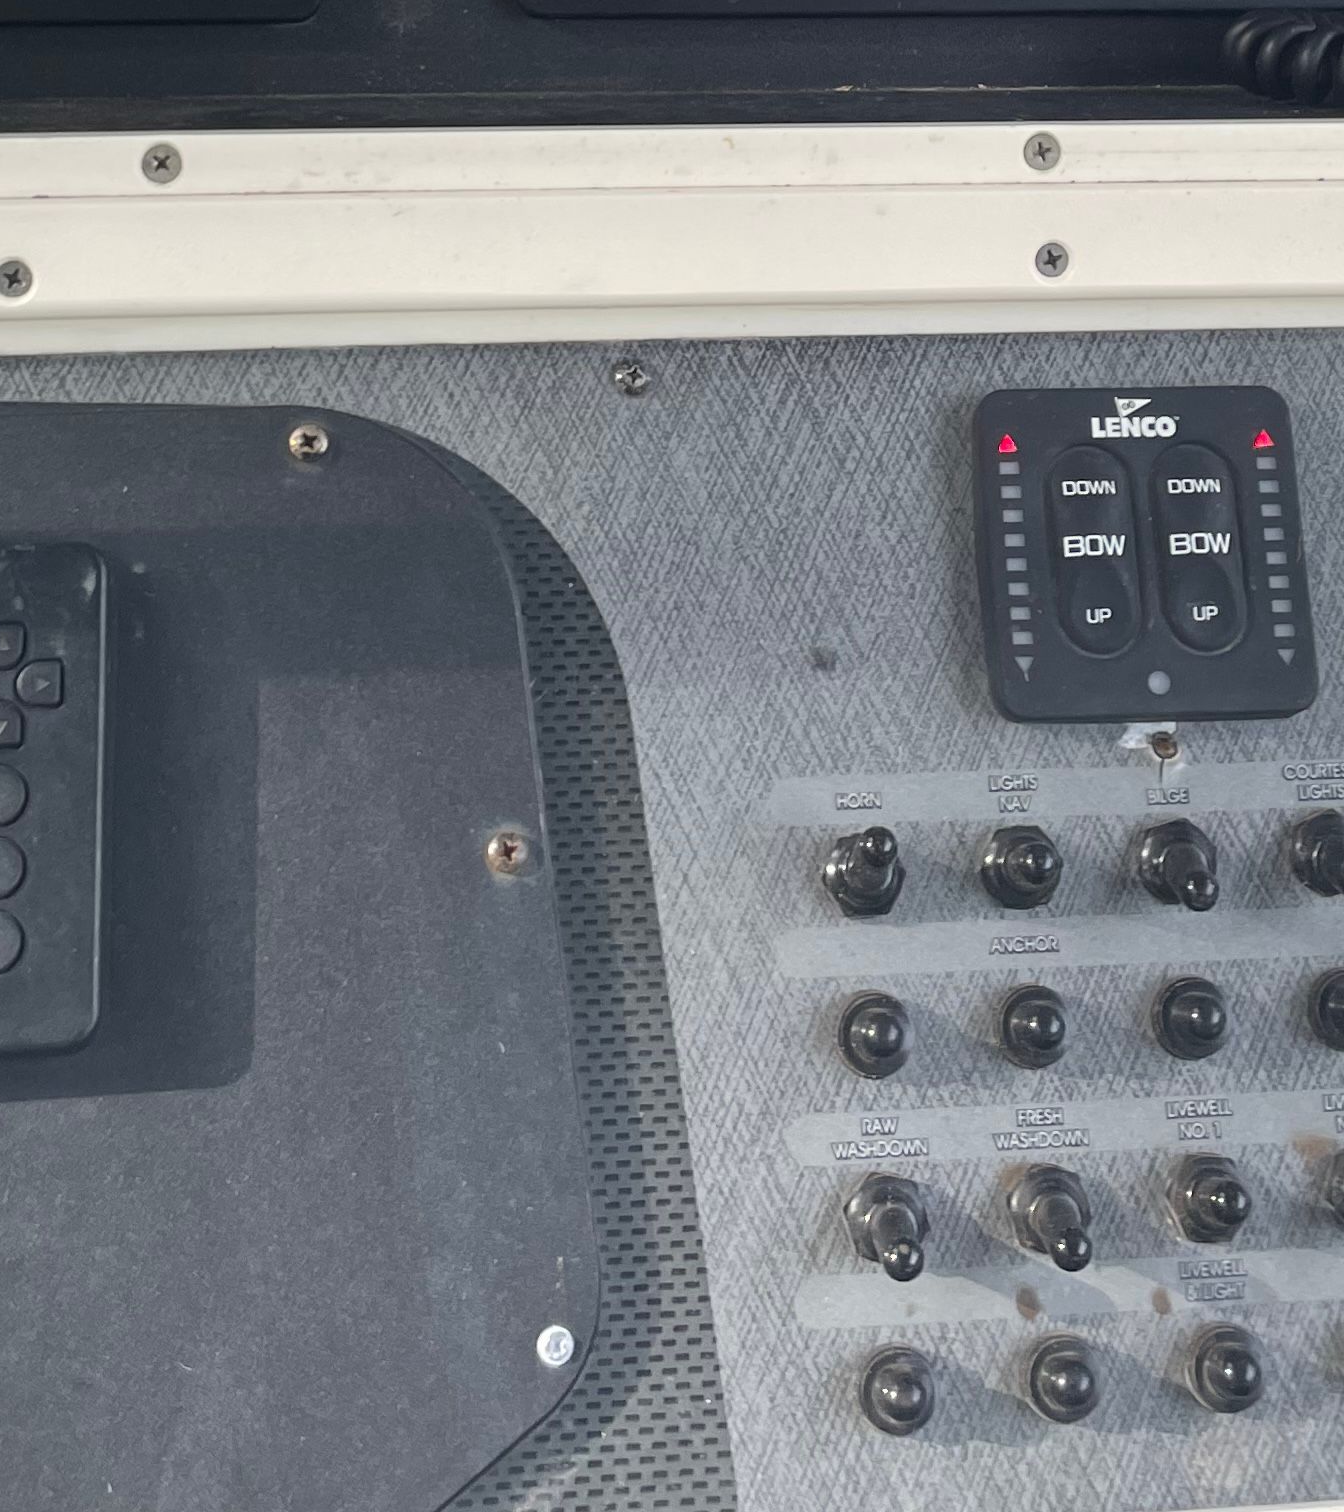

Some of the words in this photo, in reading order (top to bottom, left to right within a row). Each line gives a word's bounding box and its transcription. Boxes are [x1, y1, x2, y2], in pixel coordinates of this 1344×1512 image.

[1090, 415, 1177, 439] LENCO
[1061, 480, 1117, 496] DOWN
[1167, 478, 1222, 495] DOWN
[1062, 534, 1126, 558] BOW
[1169, 532, 1231, 556] BOW
[1085, 607, 1112, 625] UP
[1192, 605, 1219, 622] UP
[988, 774, 1039, 792] LIGHTS
[835, 792, 883, 811] HORN
[998, 795, 1032, 813] NAV
[1146, 787, 1190, 805] BILGE
[989, 935, 1060, 955] ANCHOR
[1016, 1107, 1064, 1128] FRESH
[1165, 1099, 1233, 1120] LIVEWELL
[860, 1117, 899, 1136] RAW
[1178, 1122, 1210, 1140] NO.
[1211, 1121, 1223, 1139] 1
[831, 1137, 929, 1160] WASHDOWN
[992, 1128, 1090, 1152] WASHDOWN
[1177, 1259, 1248, 1280] LIVEWELL
